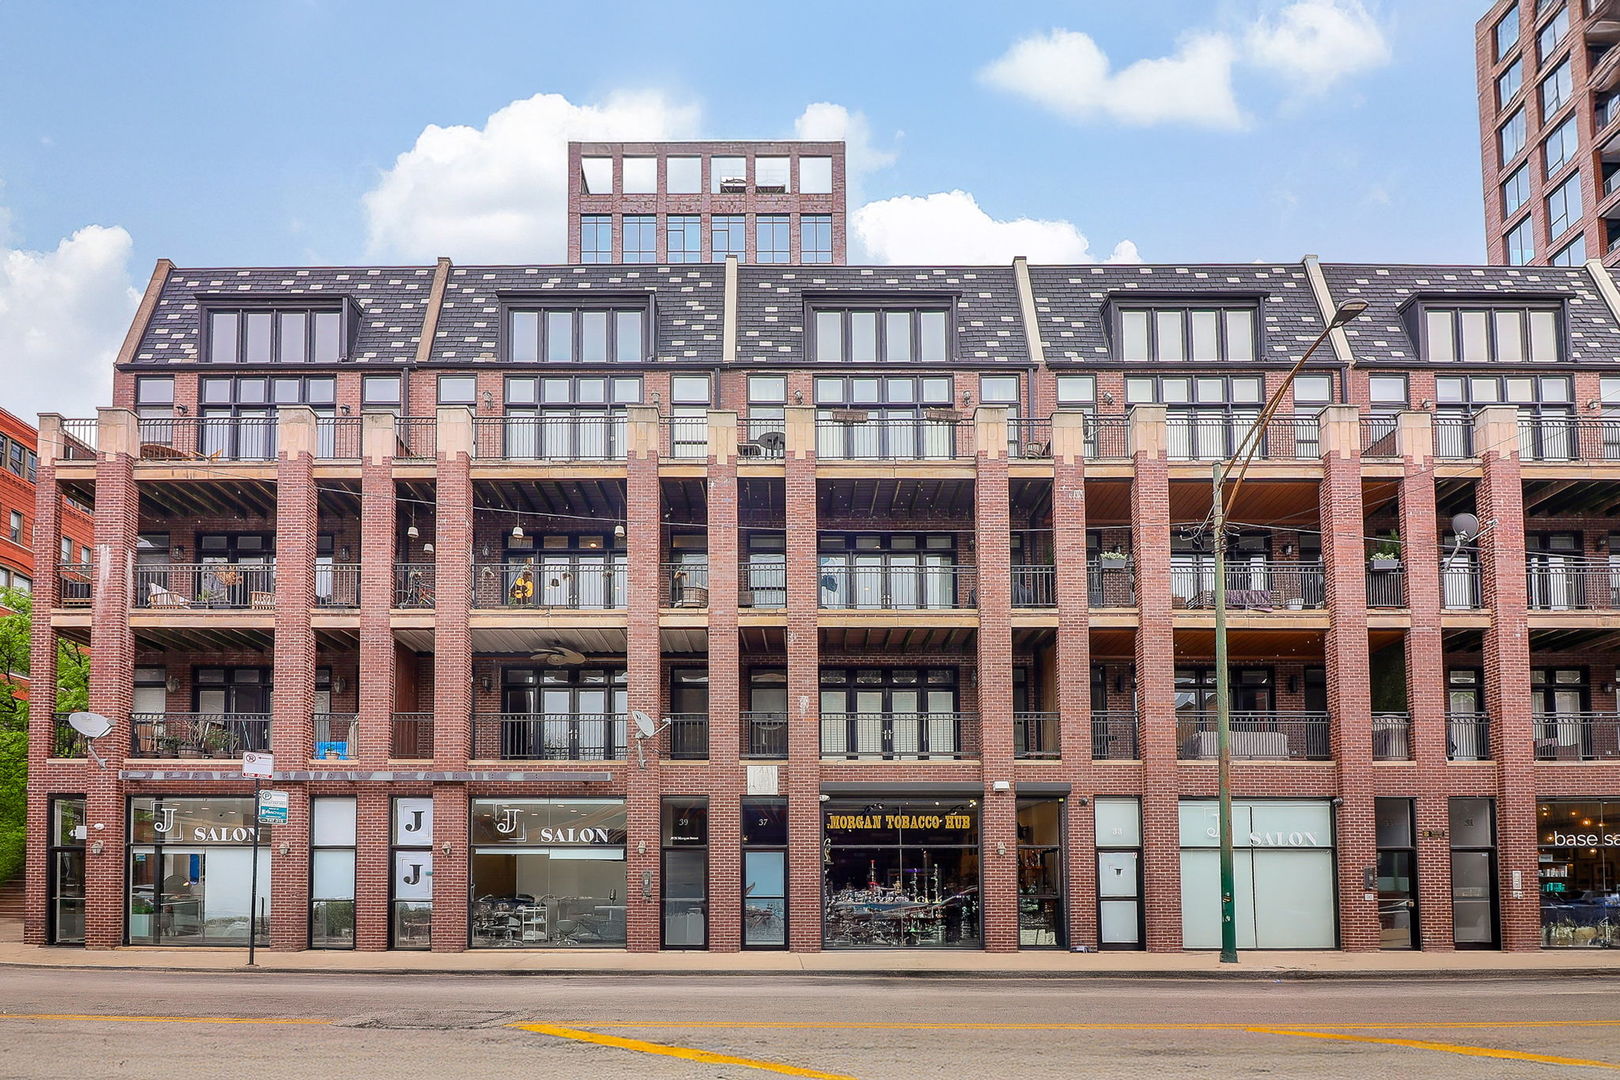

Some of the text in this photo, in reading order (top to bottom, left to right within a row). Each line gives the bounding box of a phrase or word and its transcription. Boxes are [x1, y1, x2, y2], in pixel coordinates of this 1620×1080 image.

[154, 808, 177, 832] J
[404, 810, 425, 832] J
[496, 808, 521, 833] J
[678, 818, 689, 826] 39
[758, 818, 769, 826] 37
[827, 815, 970, 829] MORGAN TOBACCO HUB
[194, 827, 262, 842] SALON
[540, 828, 611, 843] SALON
[1249, 831, 1319, 846] SALON
[1554, 830, 1599, 847] base
[403, 864, 424, 885] J
